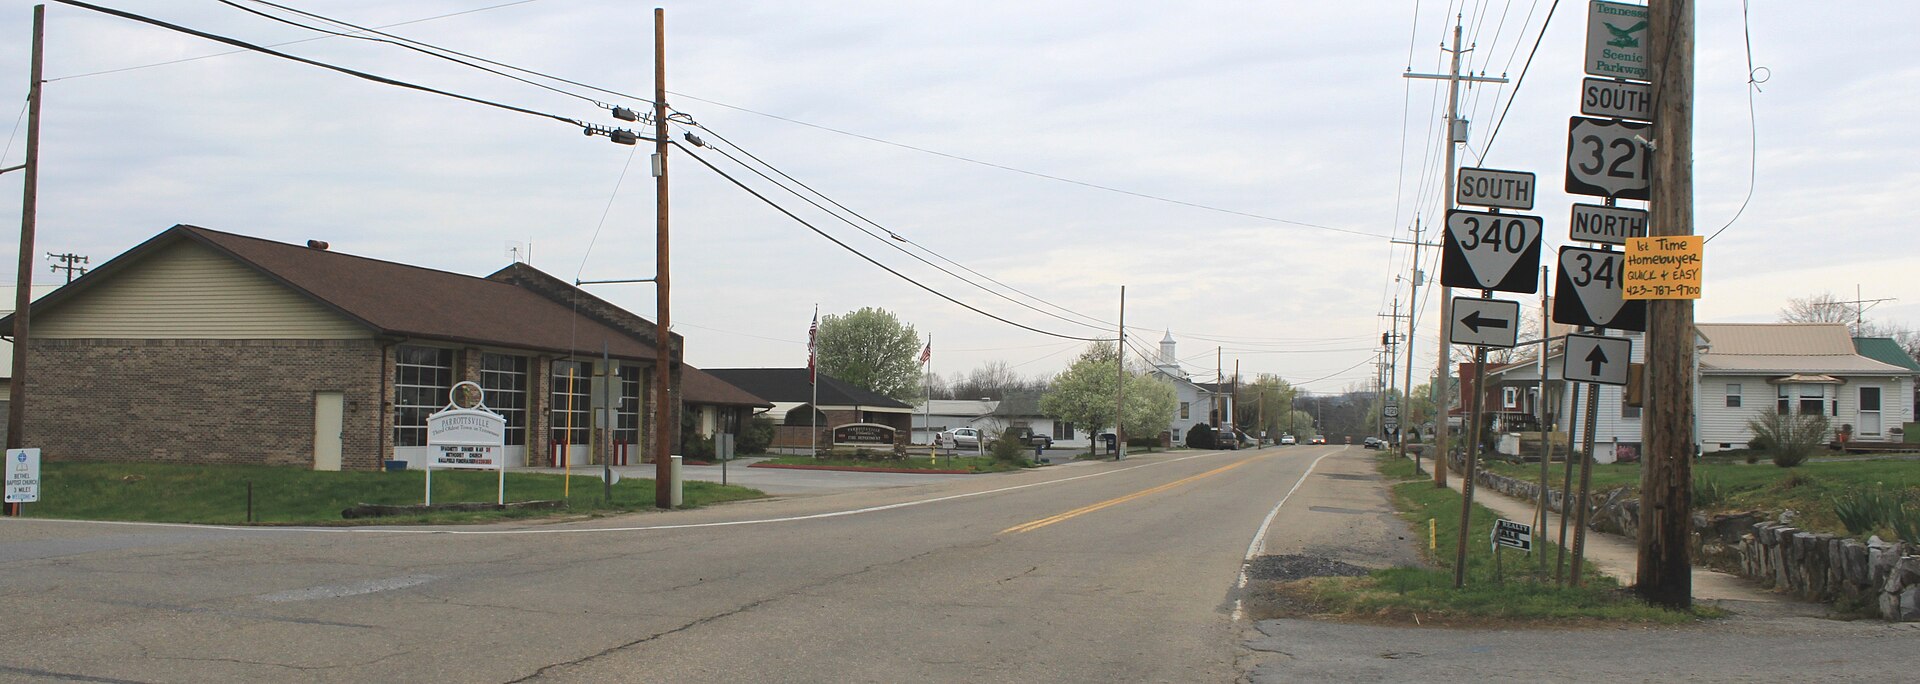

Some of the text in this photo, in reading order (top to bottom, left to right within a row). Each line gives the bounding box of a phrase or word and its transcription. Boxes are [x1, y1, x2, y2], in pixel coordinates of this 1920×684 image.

[1596, 3, 1649, 18] Tennesse
[1602, 48, 1643, 63] Scenic
[1596, 60, 1649, 78] Parkway
[1586, 86, 1651, 112] SOUTH
[1578, 135, 1649, 180] 321
[1462, 176, 1529, 202] SOUTH
[1575, 212, 1642, 238] NORTH
[1461, 216, 1526, 254] 340
[1655, 238, 1688, 251] Time
[1627, 270, 1657, 281] QUICK
[1672, 268, 1700, 281] EASY
[1626, 284, 1701, 297] 423-787-9700
[441, 416, 489, 428] PARROTTSVILLE
[1503, 521, 1528, 532] REALTY
